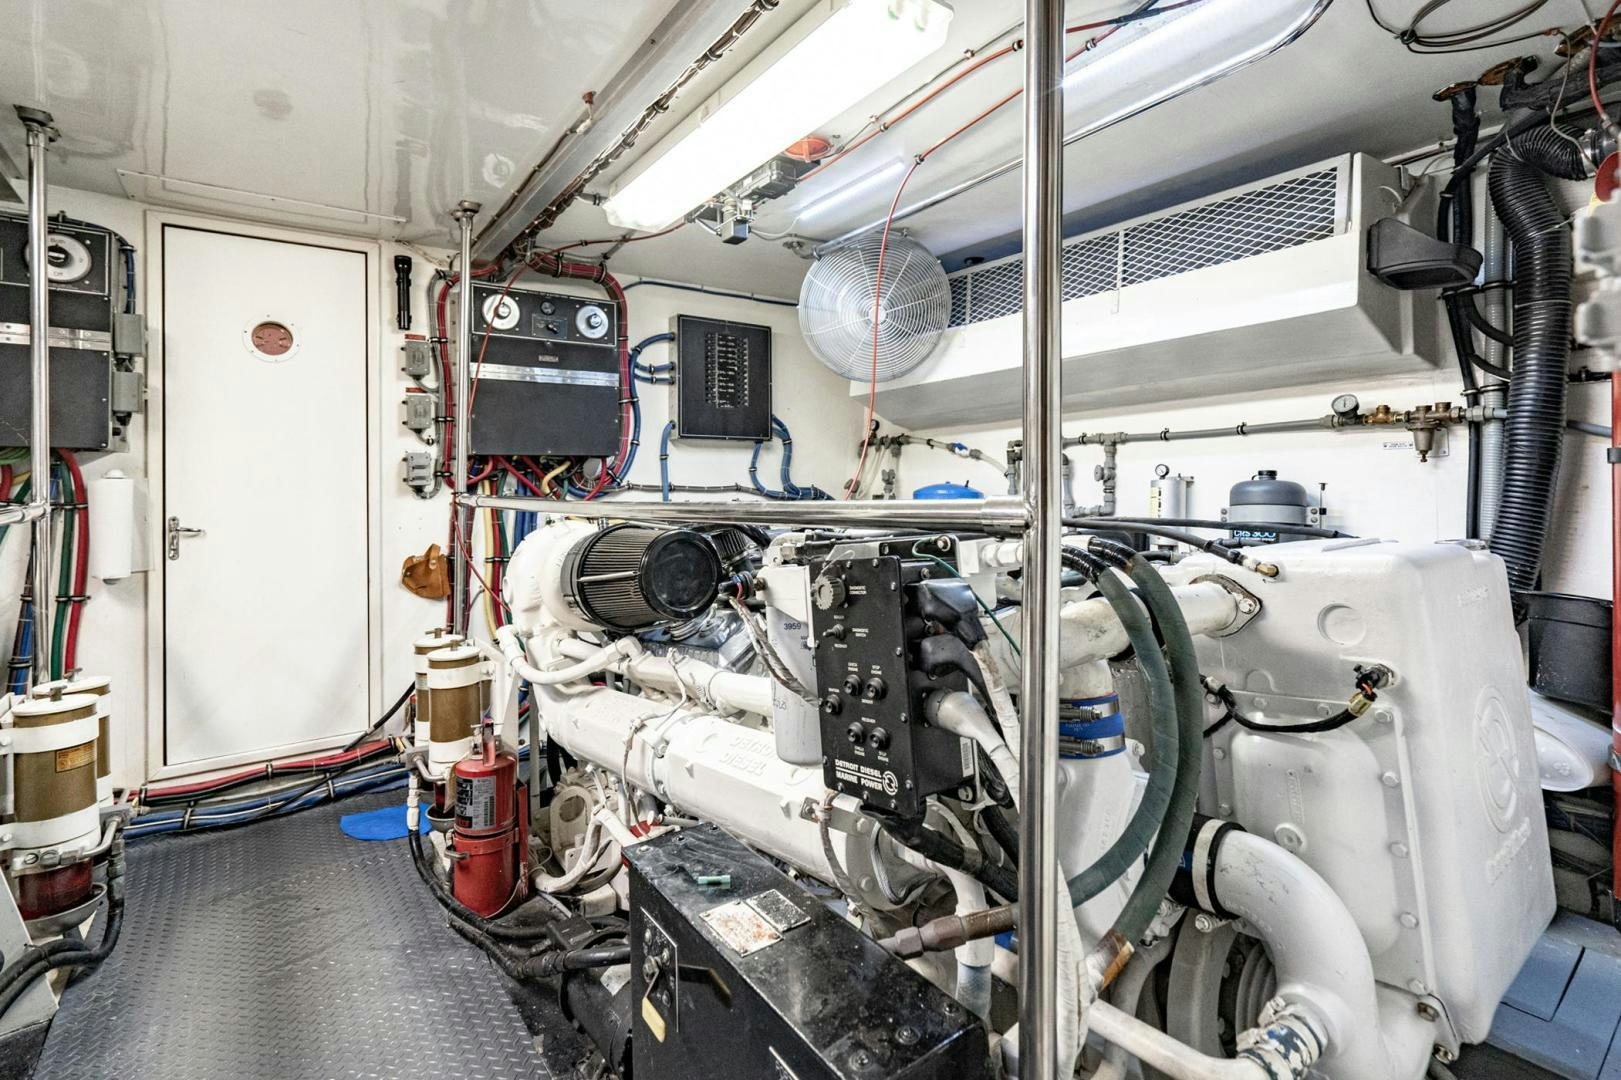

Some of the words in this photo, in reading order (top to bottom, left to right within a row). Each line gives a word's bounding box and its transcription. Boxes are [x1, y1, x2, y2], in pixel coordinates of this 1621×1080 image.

[783, 622, 802, 631] 3959
[834, 758, 859, 772] DETROIT
[860, 765, 882, 778] DIESEL
[835, 770, 859, 784] MARINE
[860, 777, 883, 791] POWER
